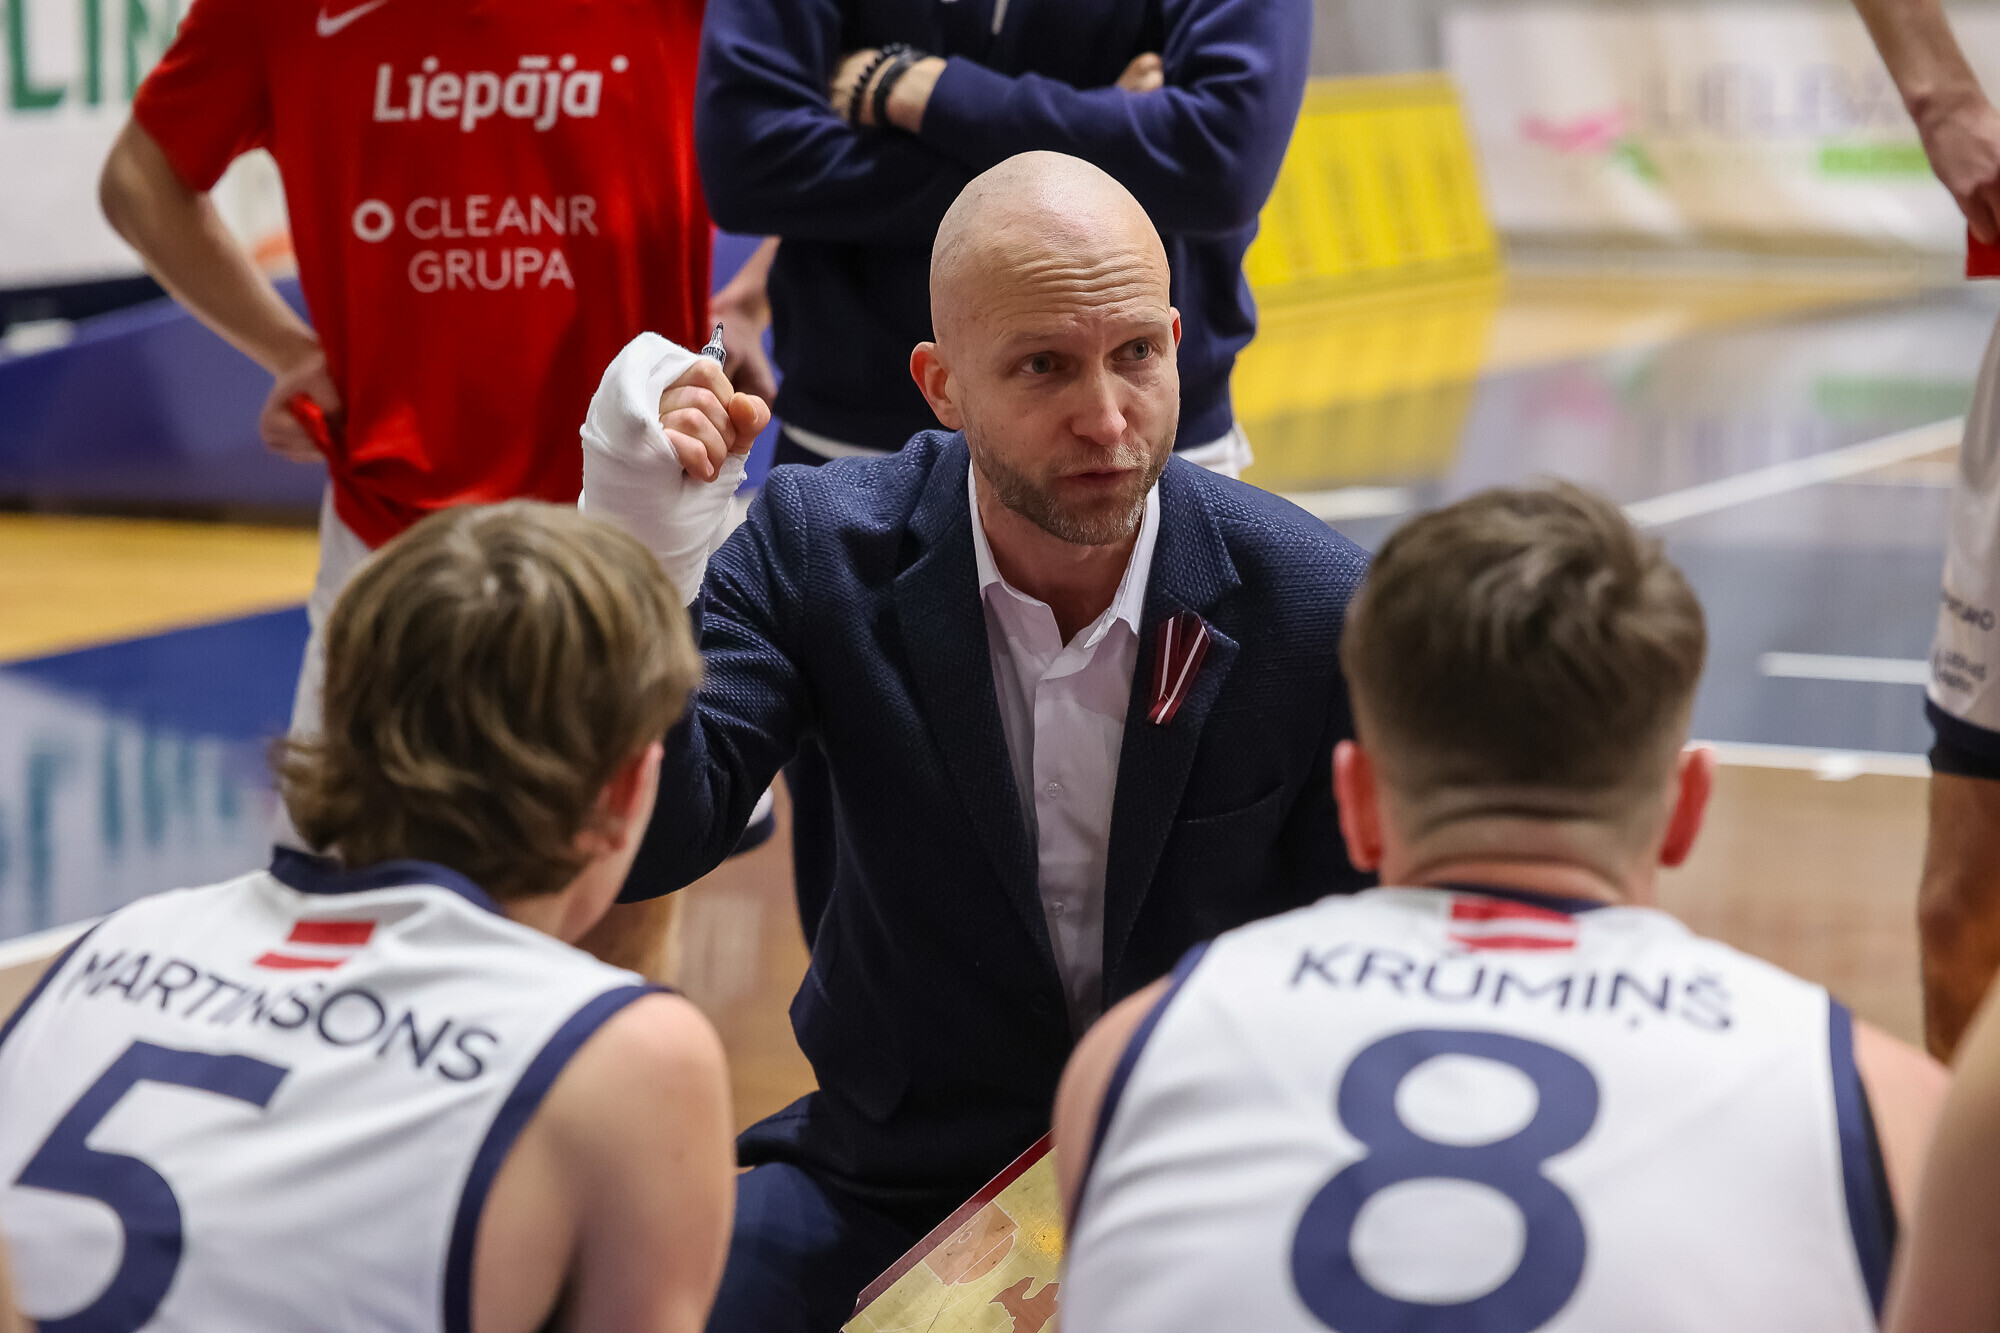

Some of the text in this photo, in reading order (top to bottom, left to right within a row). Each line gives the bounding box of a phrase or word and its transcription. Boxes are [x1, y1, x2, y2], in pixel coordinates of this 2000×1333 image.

[373, 54, 602, 132] Liepāja
[404, 194, 599, 240] CLEANR
[407, 246, 576, 293] GRUPA
[12, 1039, 291, 1333] 5
[1290, 1026, 1602, 1333] 8
